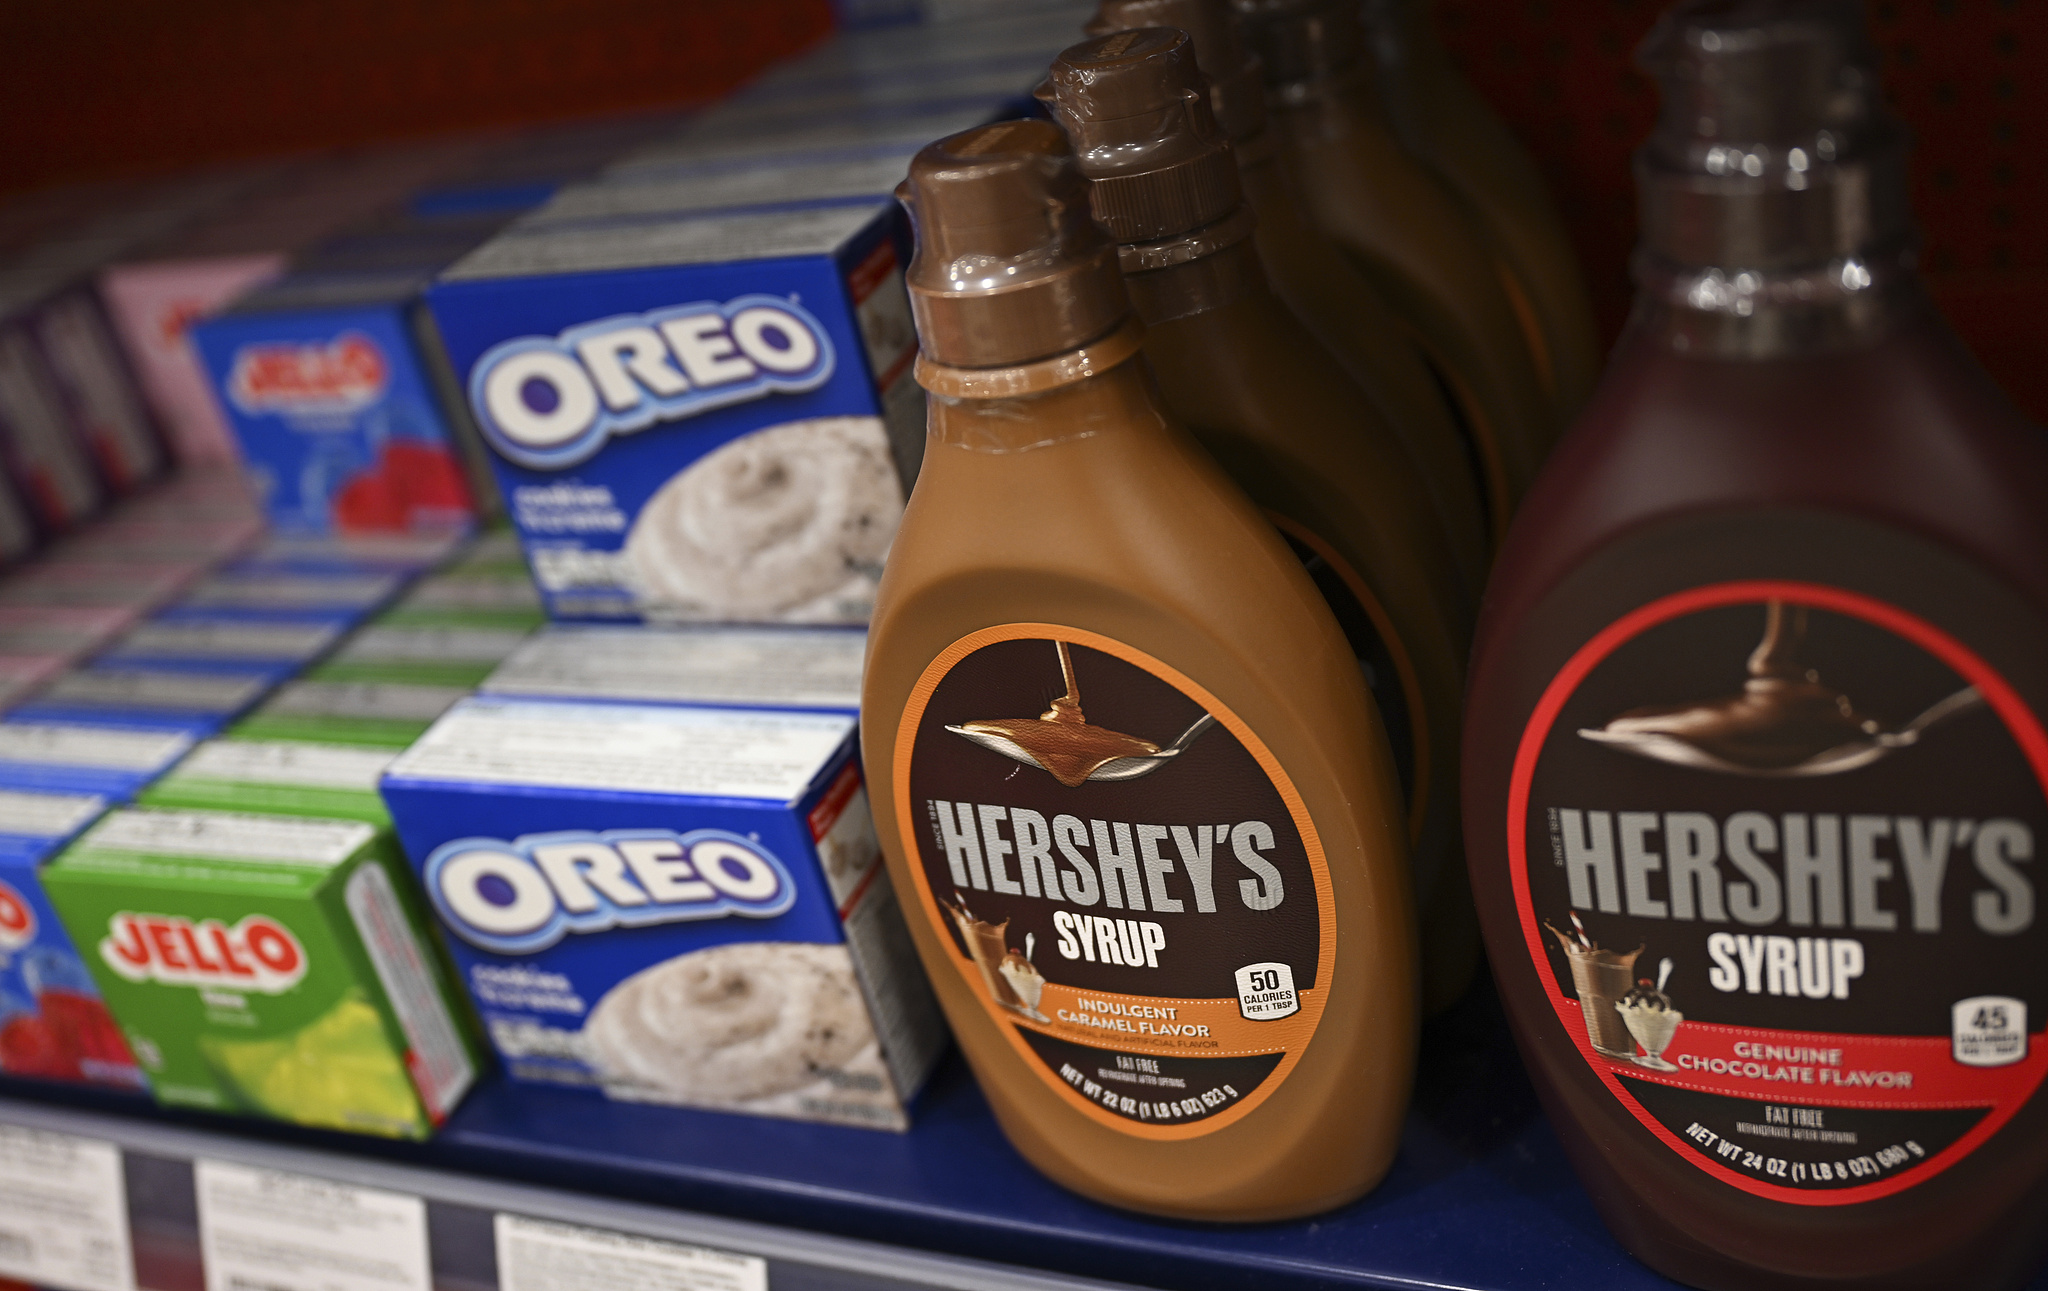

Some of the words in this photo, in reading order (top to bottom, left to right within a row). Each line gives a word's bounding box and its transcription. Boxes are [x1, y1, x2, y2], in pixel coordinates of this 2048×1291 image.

[483, 305, 818, 447] OREO
[934, 799, 1285, 913] HERSHEY'S
[1559, 807, 2035, 936] HERSHEY'S
[438, 839, 779, 935] OREO
[1053, 910, 1166, 968] SYRUP
[1706, 931, 1866, 999] SYRUP
[1249, 969, 1280, 992] 50
[1077, 997, 1178, 1021] INDULGENT
[1243, 990, 1293, 1004] CALORIES
[1246, 1004, 1263, 1013] PER
[1272, 1000, 1293, 1010] TBSP
[1057, 1009, 1136, 1034] CARAMEL
[1138, 1021, 1212, 1038] FLAVOR
[1972, 1006, 2008, 1030] 45
[1123, 1035, 1175, 1048] ARTIFICIAL
[1177, 1040, 1219, 1049] FLAVOR
[1733, 1041, 1843, 1066] GENUINE
[1116, 1055, 1135, 1071] FAT
[1135, 1058, 1160, 1074] FREE
[1677, 1054, 1815, 1084] CHOCOLATE
[1818, 1068, 1913, 1089] FLAVOR
[1060, 1062, 1085, 1087] NET
[1083, 1079, 1103, 1099] WT
[1102, 1090, 1119, 1109] 22
[1120, 1096, 1137, 1115] OZ
[1153, 1102, 1171, 1119] LB
[1171, 1102, 1182, 1118] 6
[1180, 1097, 1206, 1115] OZ)
[1201, 1087, 1227, 1108] 623
[1222, 1084, 1239, 1098] g
[1765, 1105, 1790, 1125] FAT
[1685, 1121, 1719, 1147] NET
[1716, 1138, 1743, 1161] WT
[1741, 1151, 1763, 1170] 24
[1765, 1158, 1788, 1177] OZ
[1790, 1162, 1806, 1183] (1
[1811, 1162, 1833, 1181] LB
[1834, 1161, 1848, 1180] 8
[1847, 1155, 1880, 1176] OZ)
